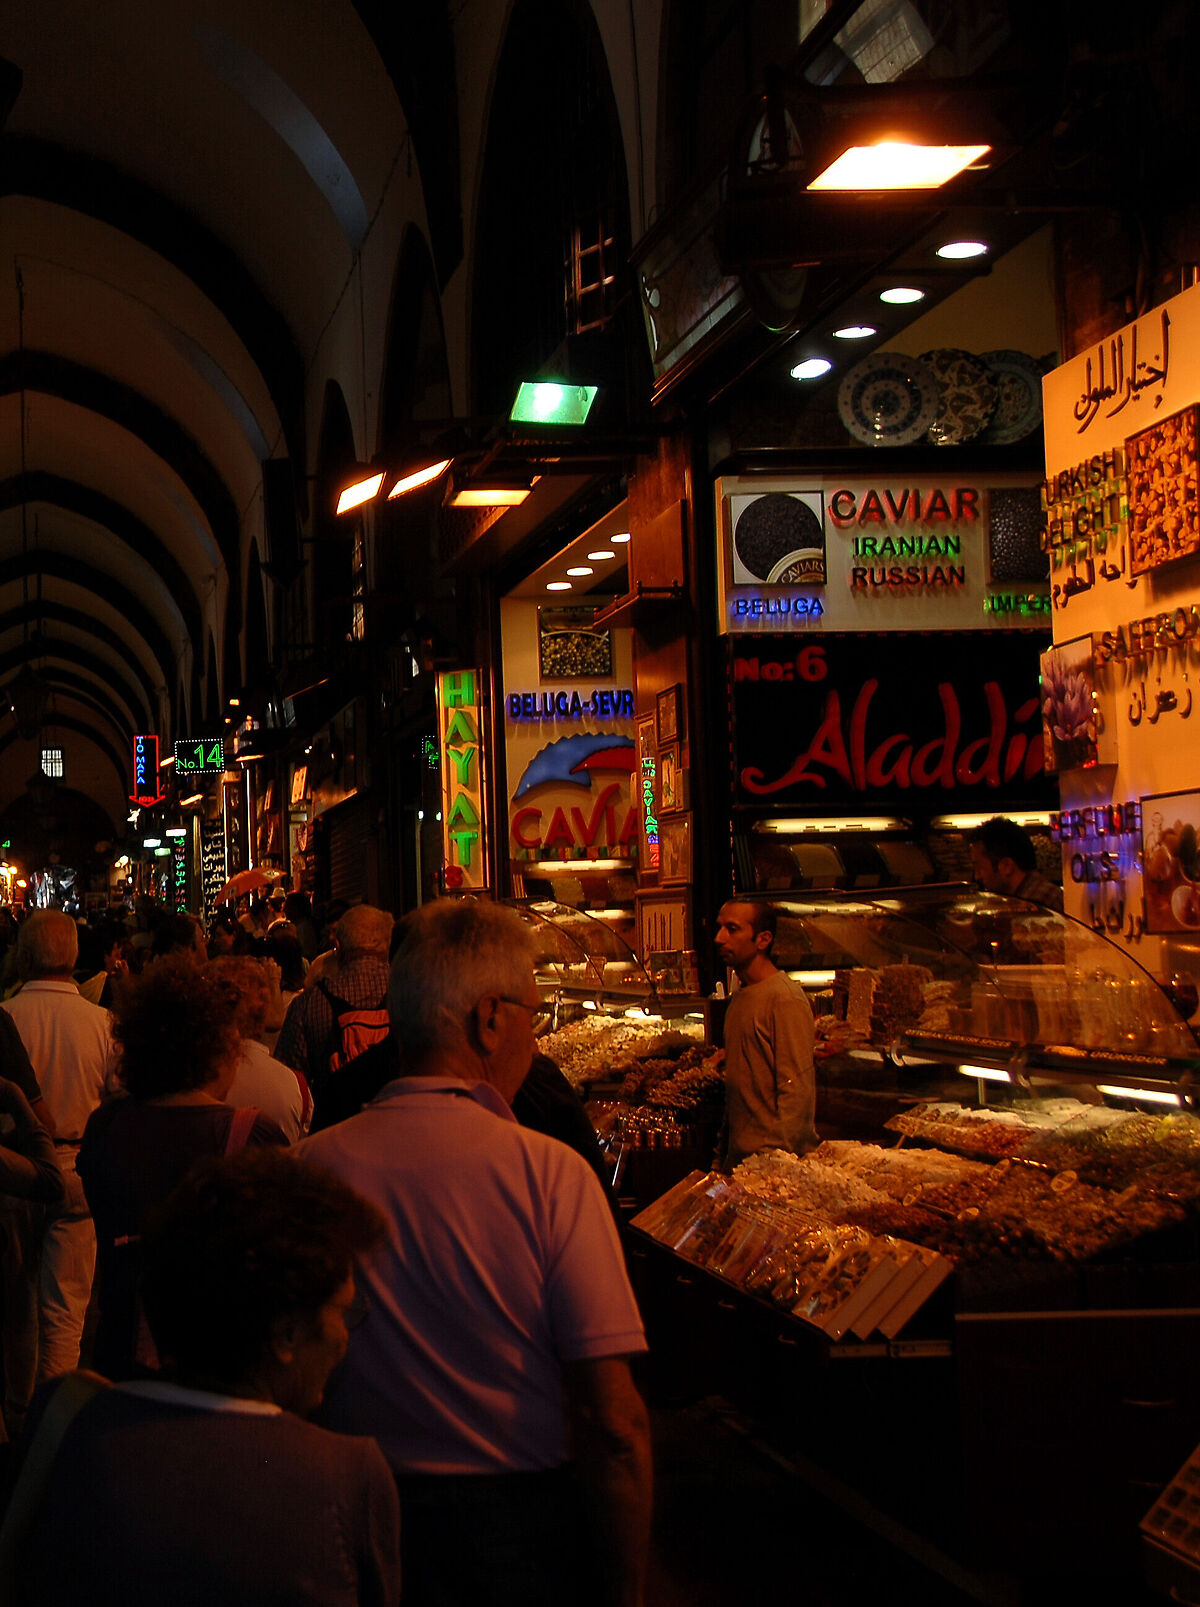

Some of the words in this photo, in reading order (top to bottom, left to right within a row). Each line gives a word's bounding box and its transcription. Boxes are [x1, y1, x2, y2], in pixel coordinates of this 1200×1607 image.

[831, 486, 980, 524] CAVIAR
[853, 535, 961, 557] IRANIAN
[851, 565, 965, 588] RUSSIAN
[736, 597, 824, 616] BELUGA
[443, 672, 479, 866] HAYAT
